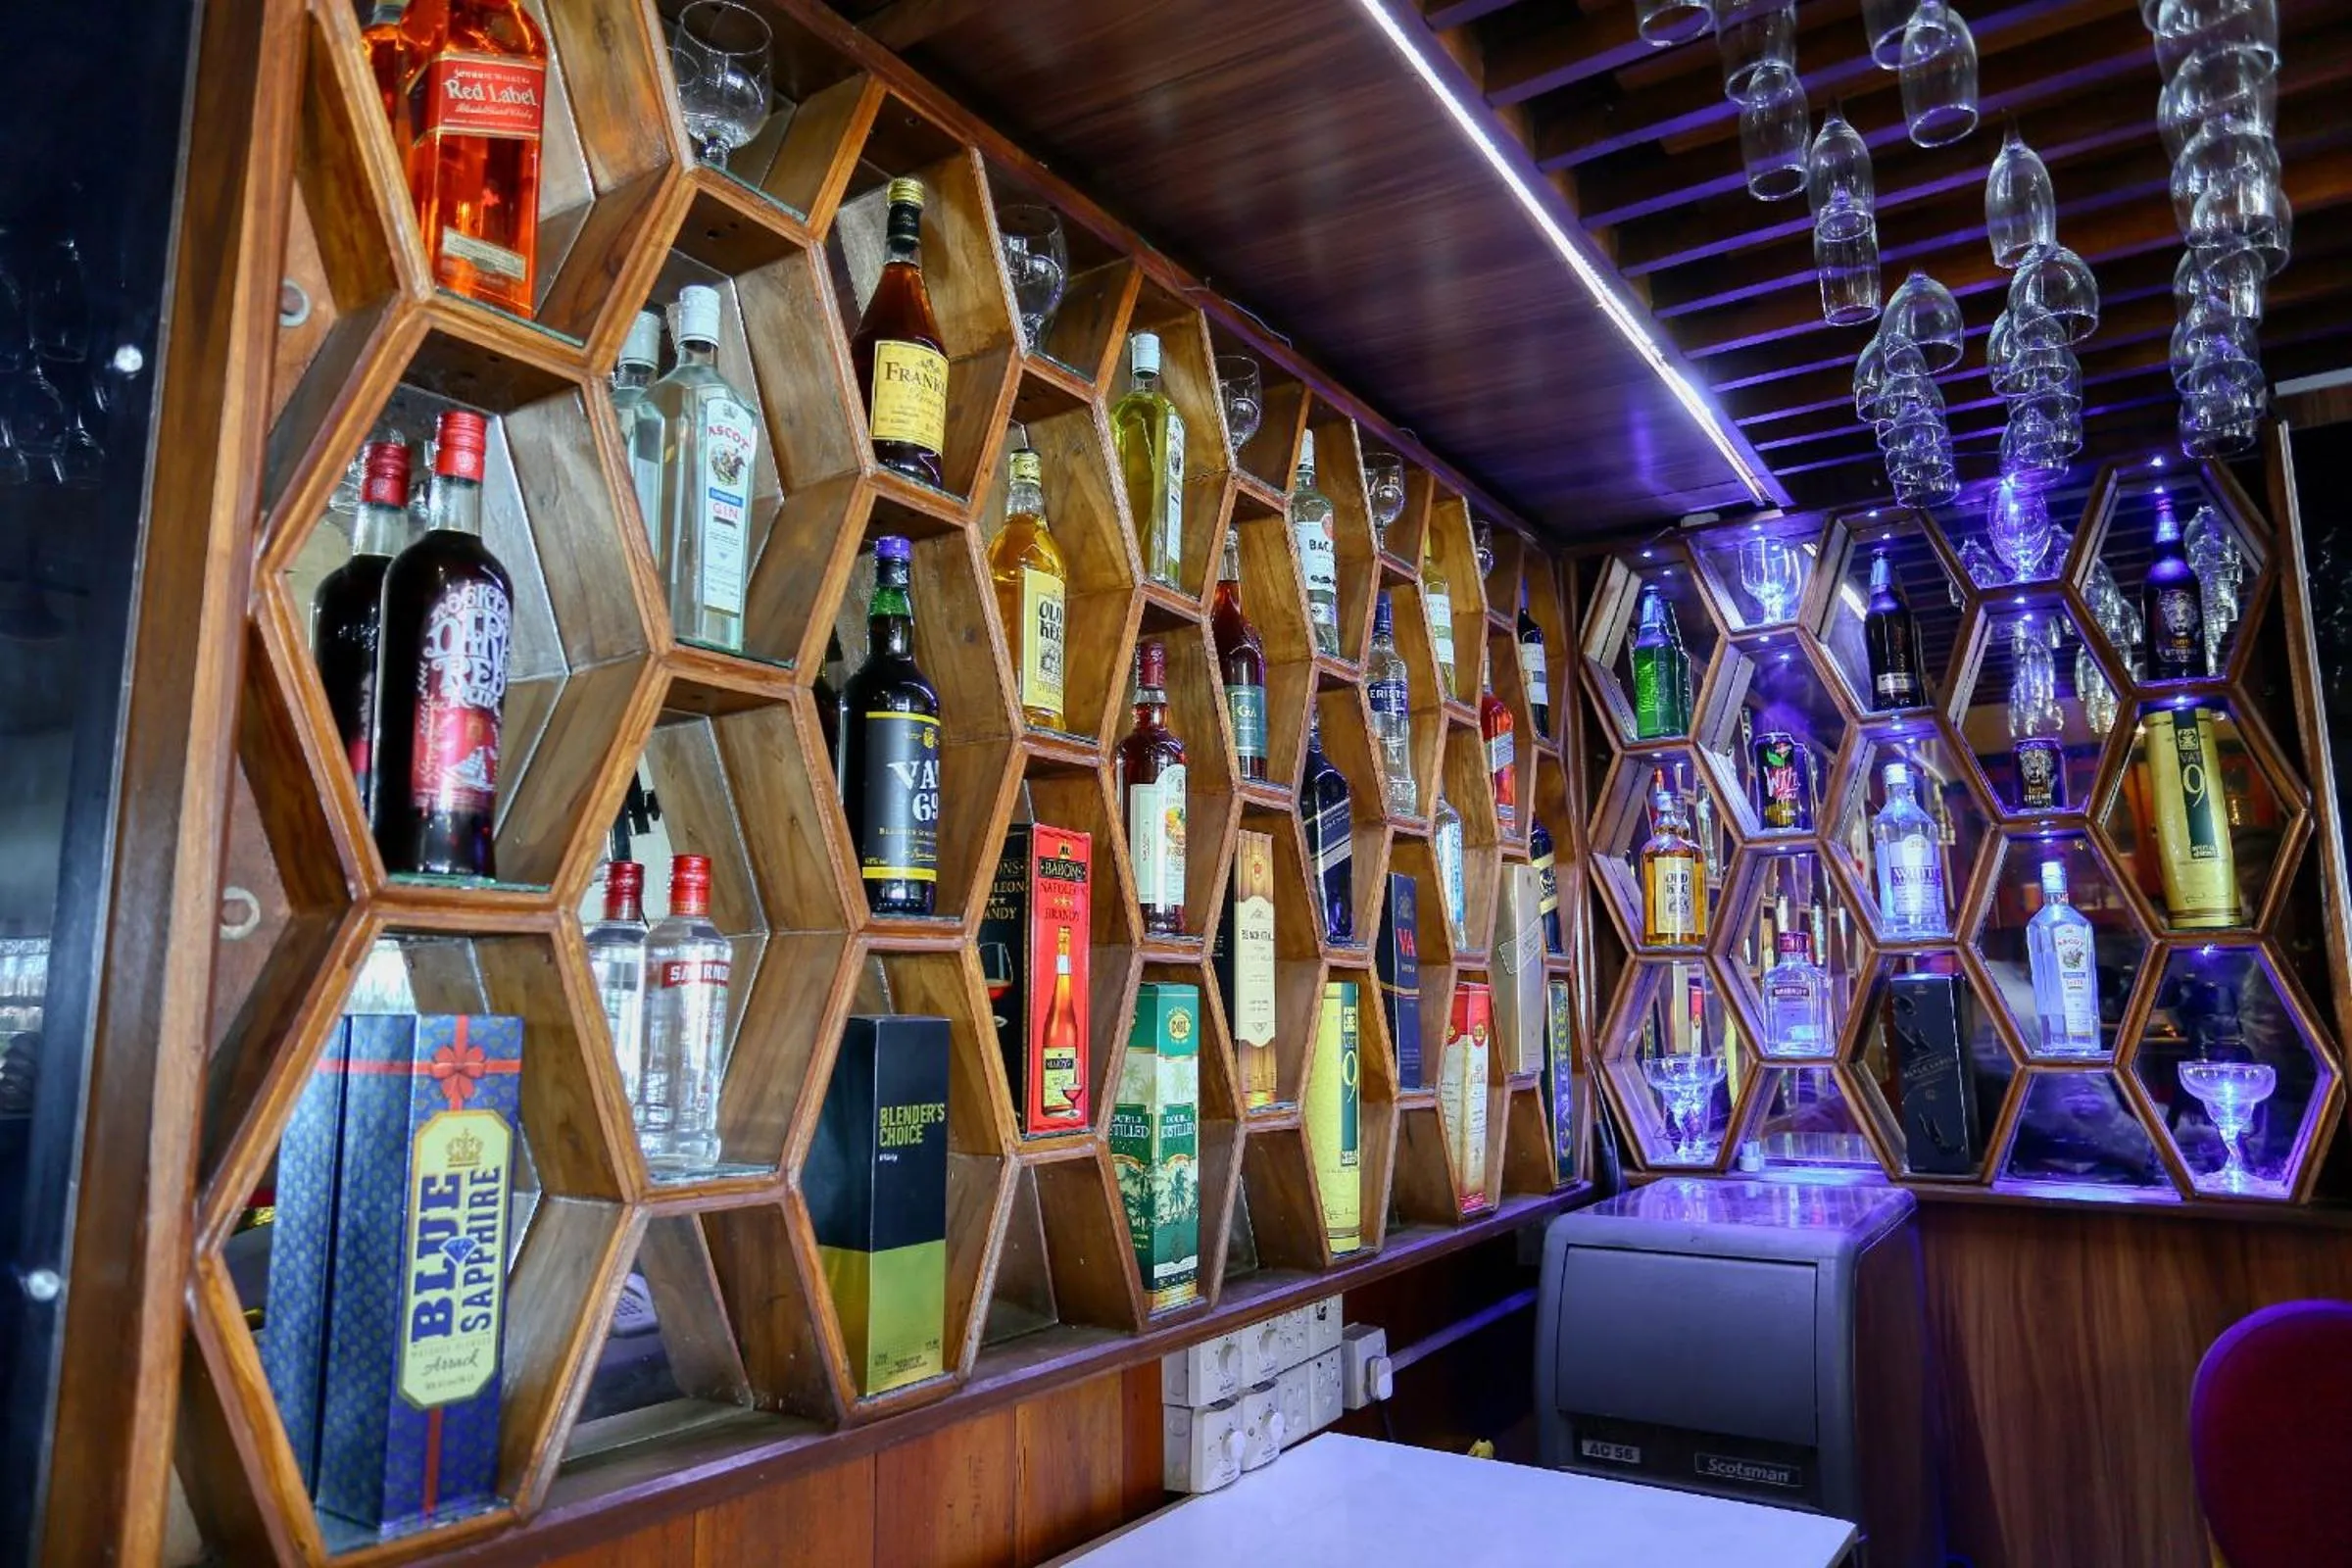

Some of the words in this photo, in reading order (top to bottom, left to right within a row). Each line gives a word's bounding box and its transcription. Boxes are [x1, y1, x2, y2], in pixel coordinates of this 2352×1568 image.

[442, 78, 486, 101] Red
[487, 83, 540, 109] Label
[709, 425, 751, 450] ASCOT
[712, 502, 738, 519] GIN
[1040, 600, 1062, 624] OLD
[886, 758, 940, 790] VA
[2182, 763, 2206, 808] 9
[1000, 860, 1020, 875] NS
[1045, 860, 1084, 878] BARONS
[1343, 1050, 1358, 1103] 9
[879, 1102, 946, 1128] BLENDER'S
[879, 1123, 924, 1148] CHOICE
[412, 1173, 462, 1343] BLUE
[461, 1165, 503, 1333] SAPPHIRE
[1589, 1443, 1610, 1456] AC
[1708, 1457, 1789, 1484] Scotsman
